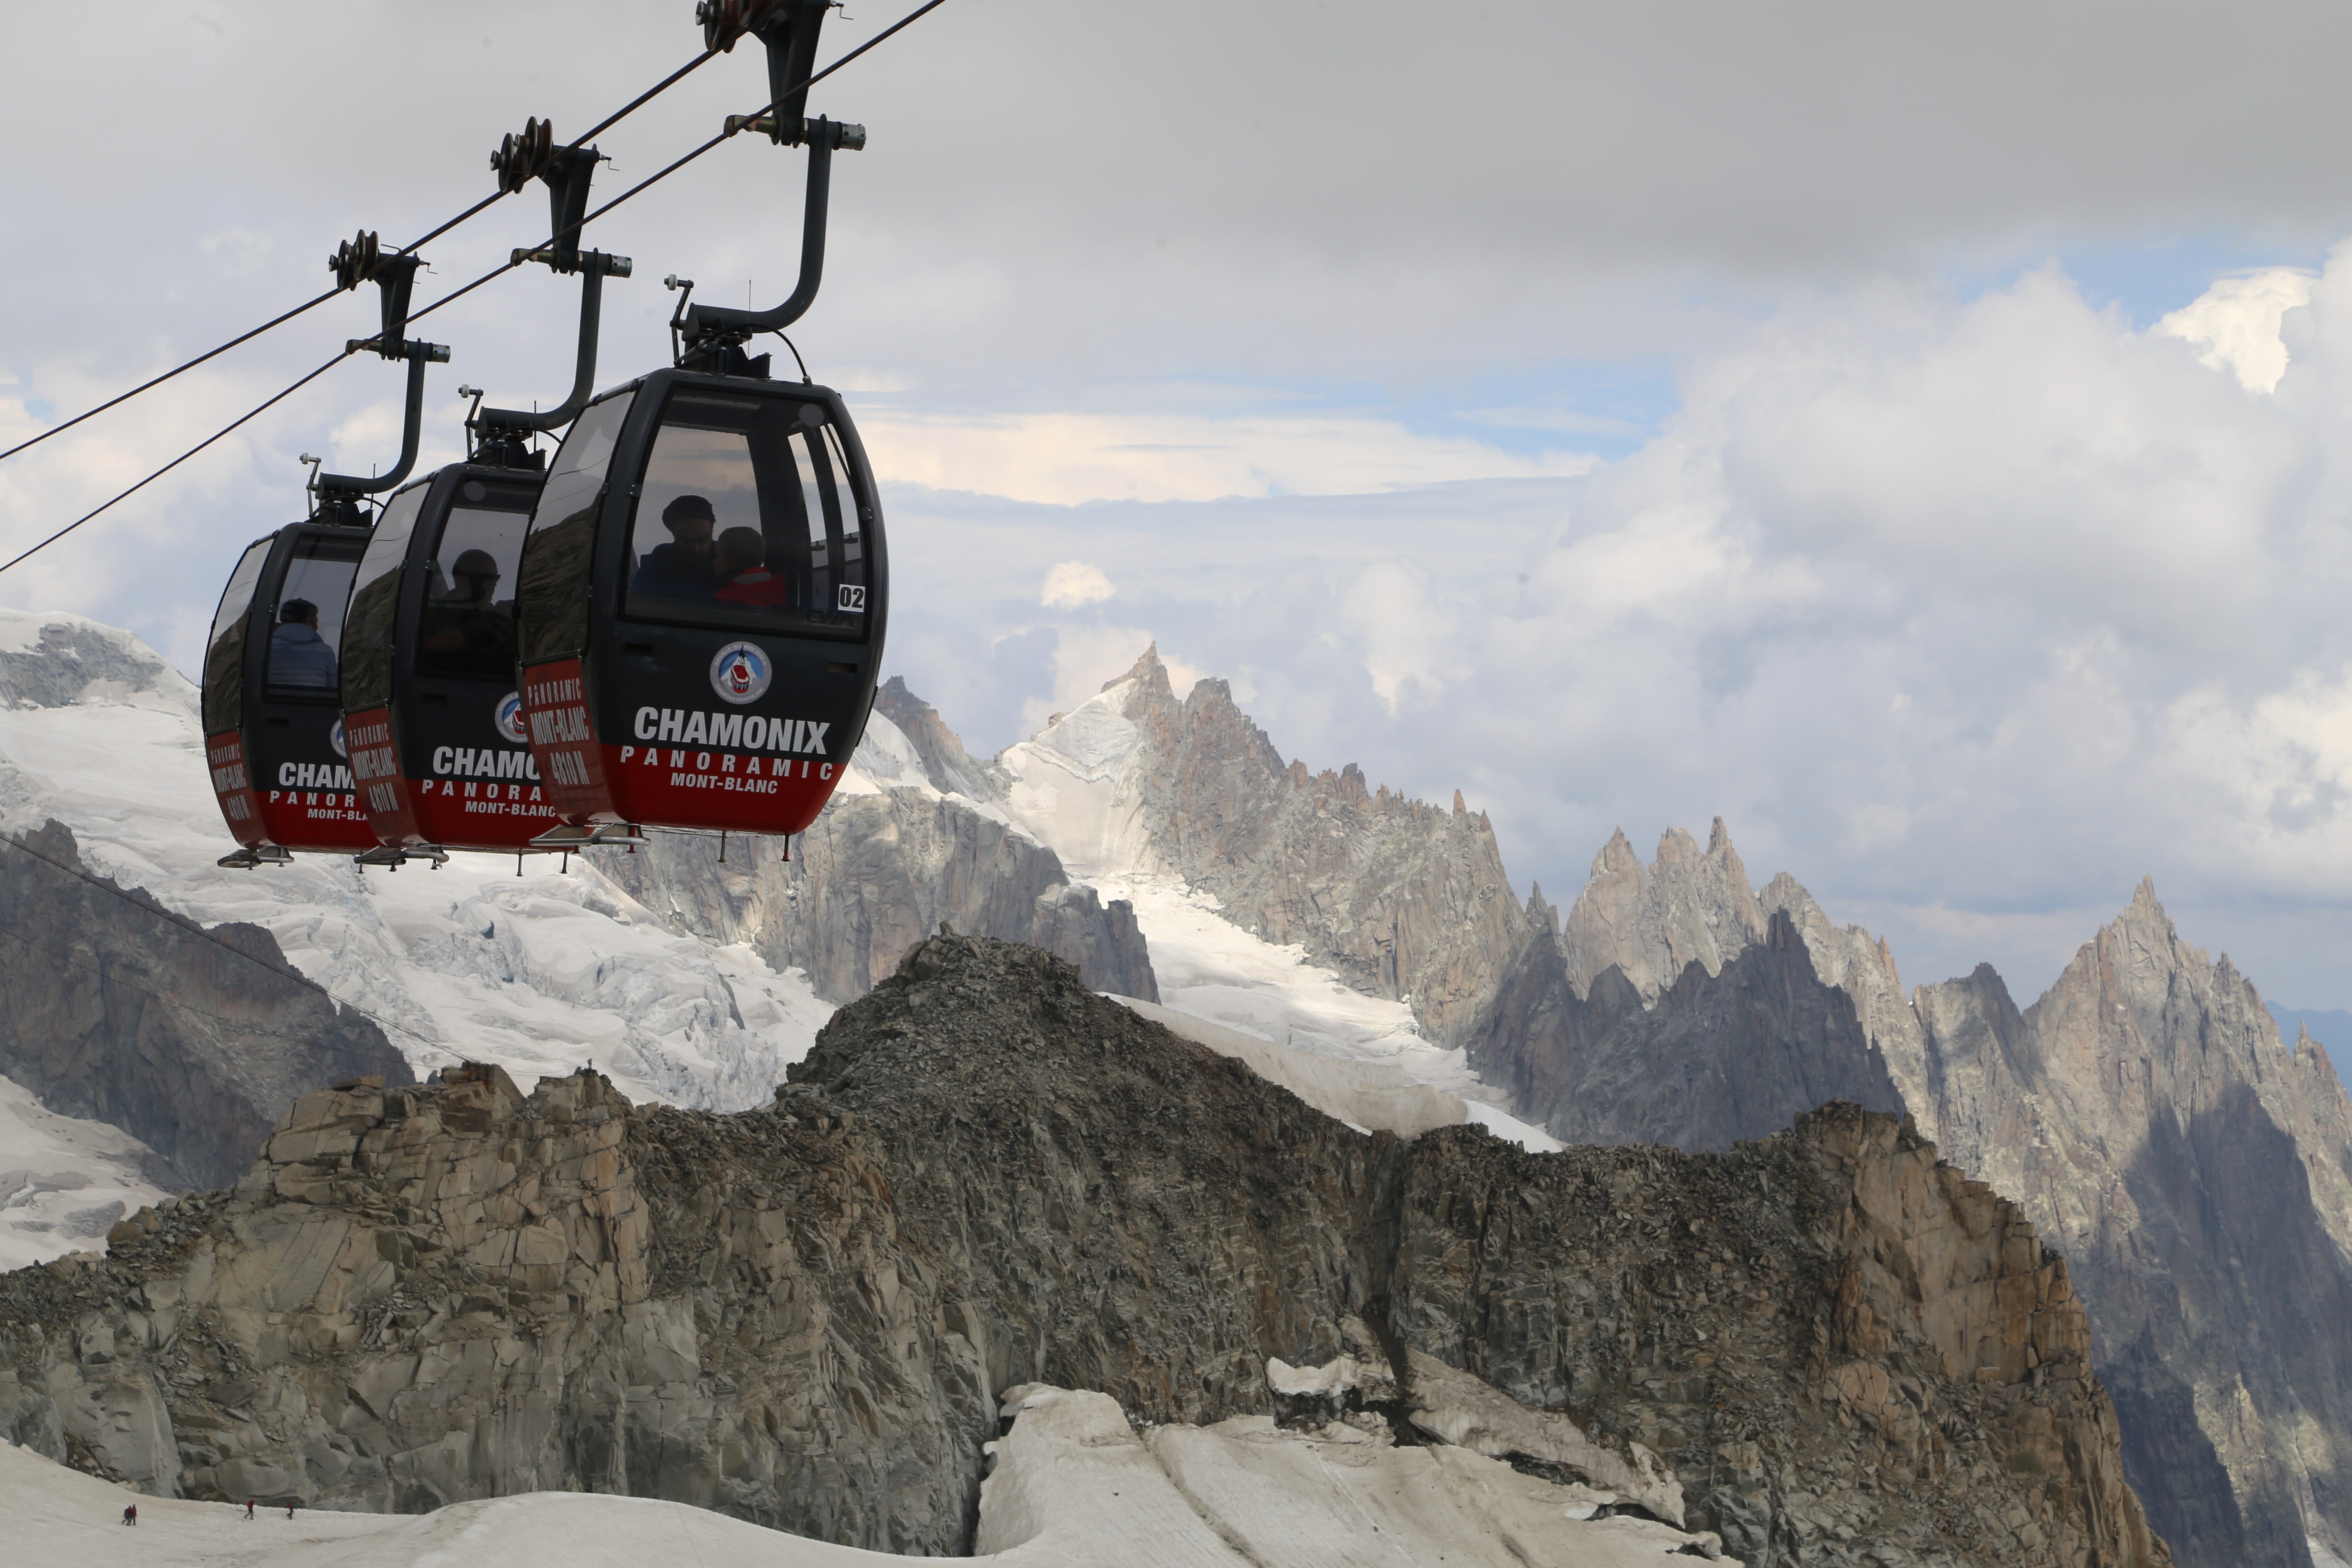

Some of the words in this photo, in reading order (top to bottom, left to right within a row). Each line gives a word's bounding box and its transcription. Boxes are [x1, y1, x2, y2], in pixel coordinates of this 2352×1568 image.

[839, 587, 864, 608] 02
[714, 646, 732, 666] AIGUILLE
[499, 695, 514, 711] AIGUILLE
[528, 677, 581, 706] PANORAMIC
[715, 683, 735, 701] CHAMONIX
[736, 686, 764, 702] MONT-BLANC
[349, 723, 389, 747] PANORAMIC
[530, 706, 589, 745] MONT-BLANC
[634, 706, 830, 755] CHAMONIX
[211, 743, 240, 765] PANORAMIC
[352, 746, 396, 780] MONT-BLANC
[620, 746, 833, 780] PANORAMIC
[214, 763, 247, 793] MONT-BLANC
[551, 752, 578, 785] 4810
[573, 750, 590, 784] M
[422, 779, 541, 801] PANORA
[671, 772, 778, 794] MONT-BLANC
[227, 796, 245, 821] 4810
[270, 790, 355, 807] PANOR
[369, 783, 391, 813] 4810
[385, 782, 399, 811] M
[465, 801, 556, 817] MONT-BLANC
